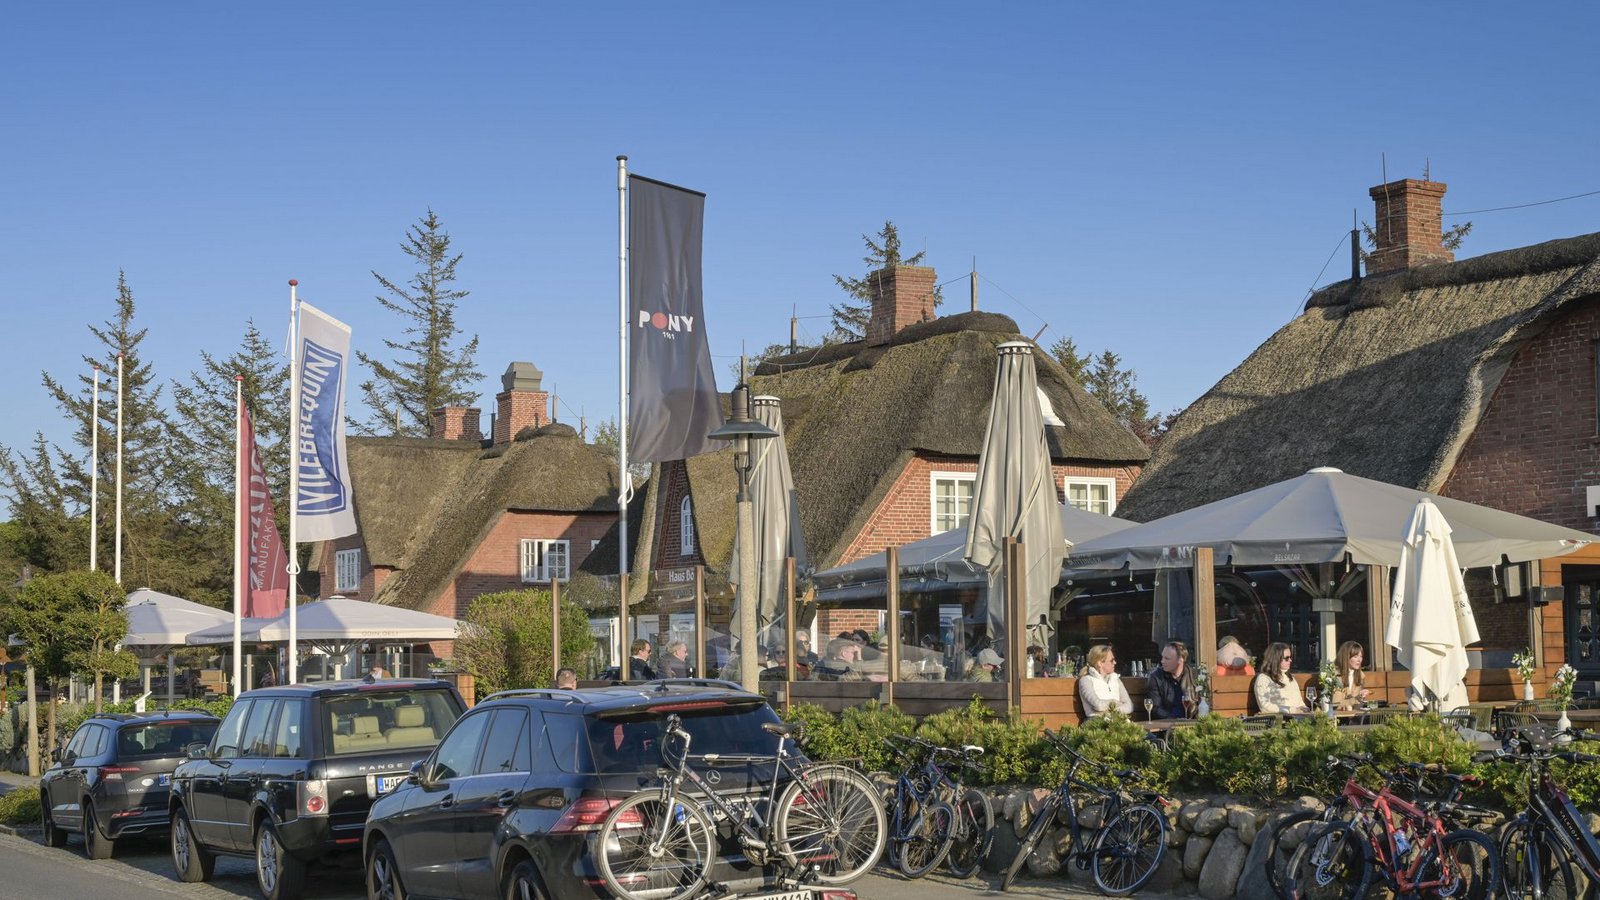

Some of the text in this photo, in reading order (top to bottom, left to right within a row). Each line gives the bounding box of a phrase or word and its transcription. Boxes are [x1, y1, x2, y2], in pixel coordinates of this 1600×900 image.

[638, 310, 694, 332] PONY
[298, 351, 339, 506] VILEBREQUIN
[669, 571, 685, 582] Haus
[360, 763, 404, 771] RANGE
